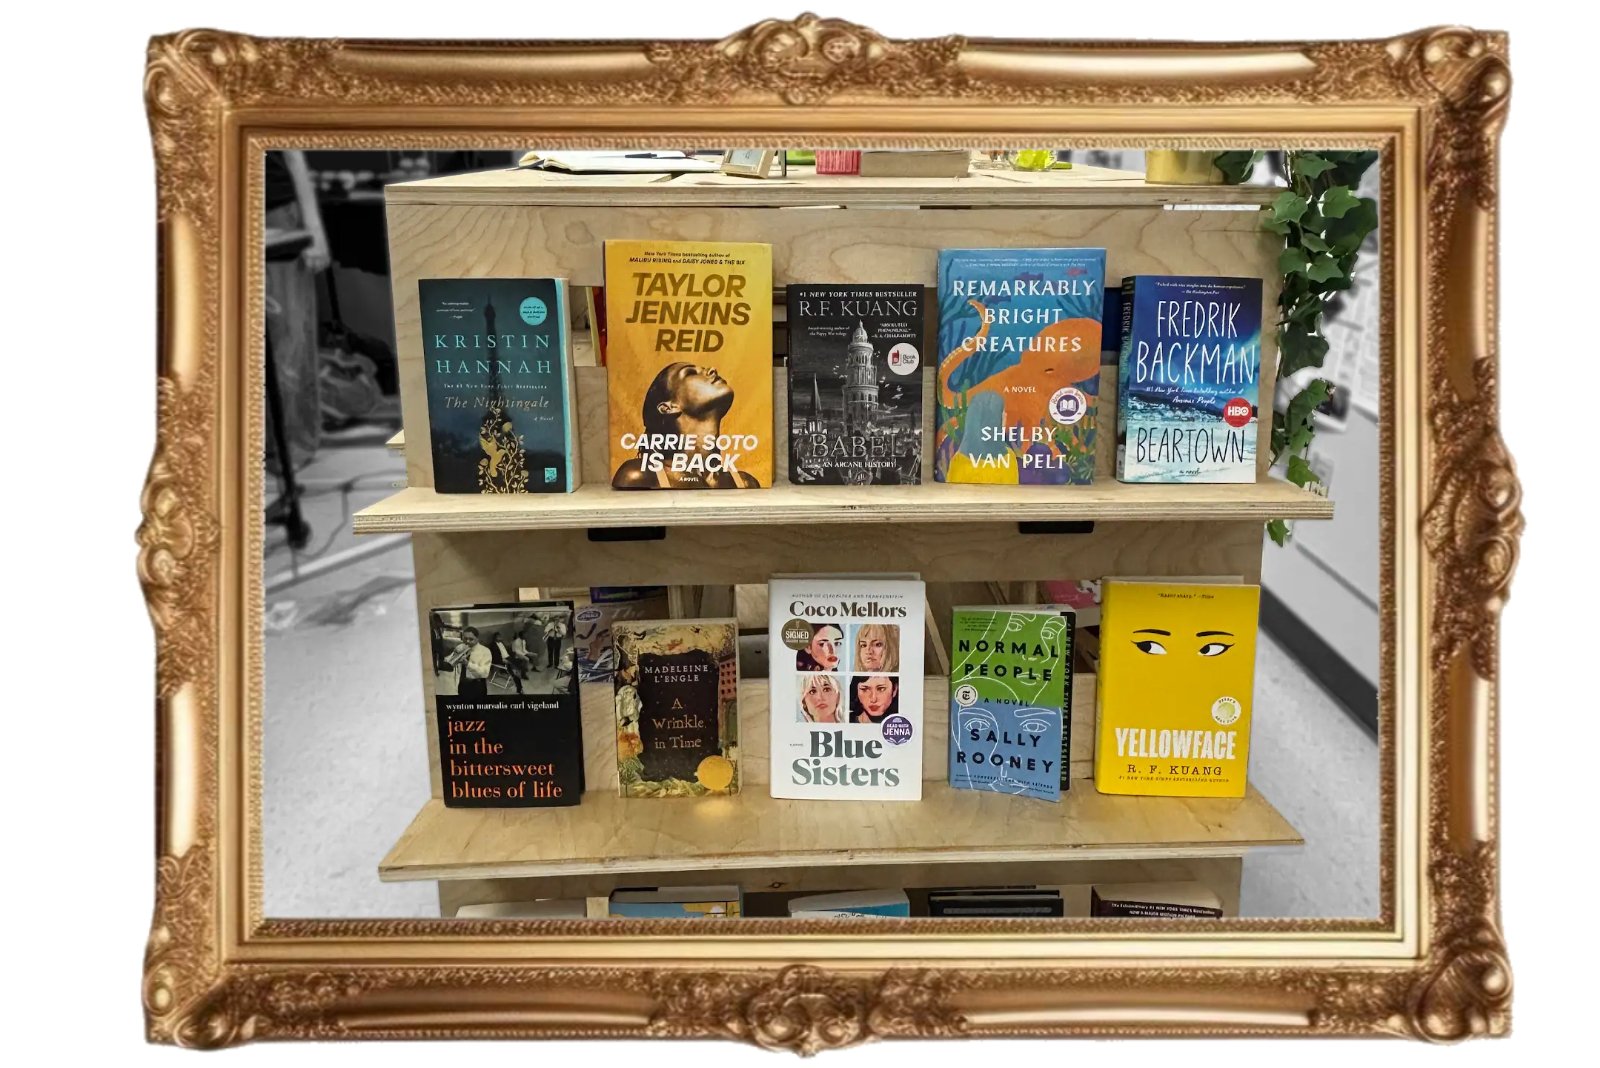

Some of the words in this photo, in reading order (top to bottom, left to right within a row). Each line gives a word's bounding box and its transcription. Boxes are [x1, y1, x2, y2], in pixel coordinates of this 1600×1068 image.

[632, 272, 746, 298] TAYLOR
[953, 280, 1096, 296] REMARKABLY
[625, 300, 751, 326] JENKINS
[800, 300, 833, 316] R.F.
[841, 300, 917, 316] KUANG
[984, 308, 1063, 324] BRIGHT
[1157, 301, 1240, 339] FREDRIK
[435, 334, 550, 348] KRISTIN
[655, 329, 724, 353] REID
[962, 336, 1082, 352] CREATURES
[436, 360, 551, 374] HANNAH
[1136, 341, 1256, 384] BACKMAN
[445, 397, 467, 408] The
[474, 396, 549, 411] Nightingale
[1196, 397, 1216, 406] People
[1228, 406, 1248, 416] HBO
[620, 433, 697, 451] CARRIE
[702, 434, 758, 451] SOTO
[981, 426, 1057, 442] SHELBY
[811, 434, 906, 457] BABEL
[1136, 427, 1244, 463] BEARTOWN
[640, 452, 664, 472] IS
[671, 453, 740, 473] BACK
[969, 454, 1011, 468] VAN
[1023, 454, 1066, 469] PELT
[790, 601, 837, 617] Coco
[840, 602, 907, 617] Mellors
[786, 630, 809, 639] SIGNED
[959, 640, 1058, 658] NORMAL
[645, 665, 709, 674] MADELEINE
[964, 664, 1052, 682] PEOPLE
[654, 675, 700, 683] L'ENGLE
[446, 703, 474, 712] wynton
[510, 701, 524, 709] carl
[527, 701, 559, 711] vigeland
[672, 698, 683, 710] A
[997, 699, 1029, 707] NOVEL
[448, 716, 485, 737] jazz
[652, 715, 704, 729] Wrinkle
[449, 739, 466, 754] in
[474, 737, 503, 754] the
[655, 738, 665, 749] in
[669, 736, 702, 748] Time
[810, 730, 882, 759] Blue
[970, 729, 1041, 747] SALLY
[1114, 728, 1238, 760] YELLOWFACE
[450, 760, 555, 776] bittersweet
[957, 752, 1054, 773] ROONEY
[1128, 764, 1141, 773] R.
[1150, 765, 1161, 774] F.
[1170, 766, 1222, 775] KUANG
[792, 758, 900, 787] Sisters
[452, 781, 500, 798] blues
[507, 781, 526, 798] of
[533, 781, 562, 798] life
